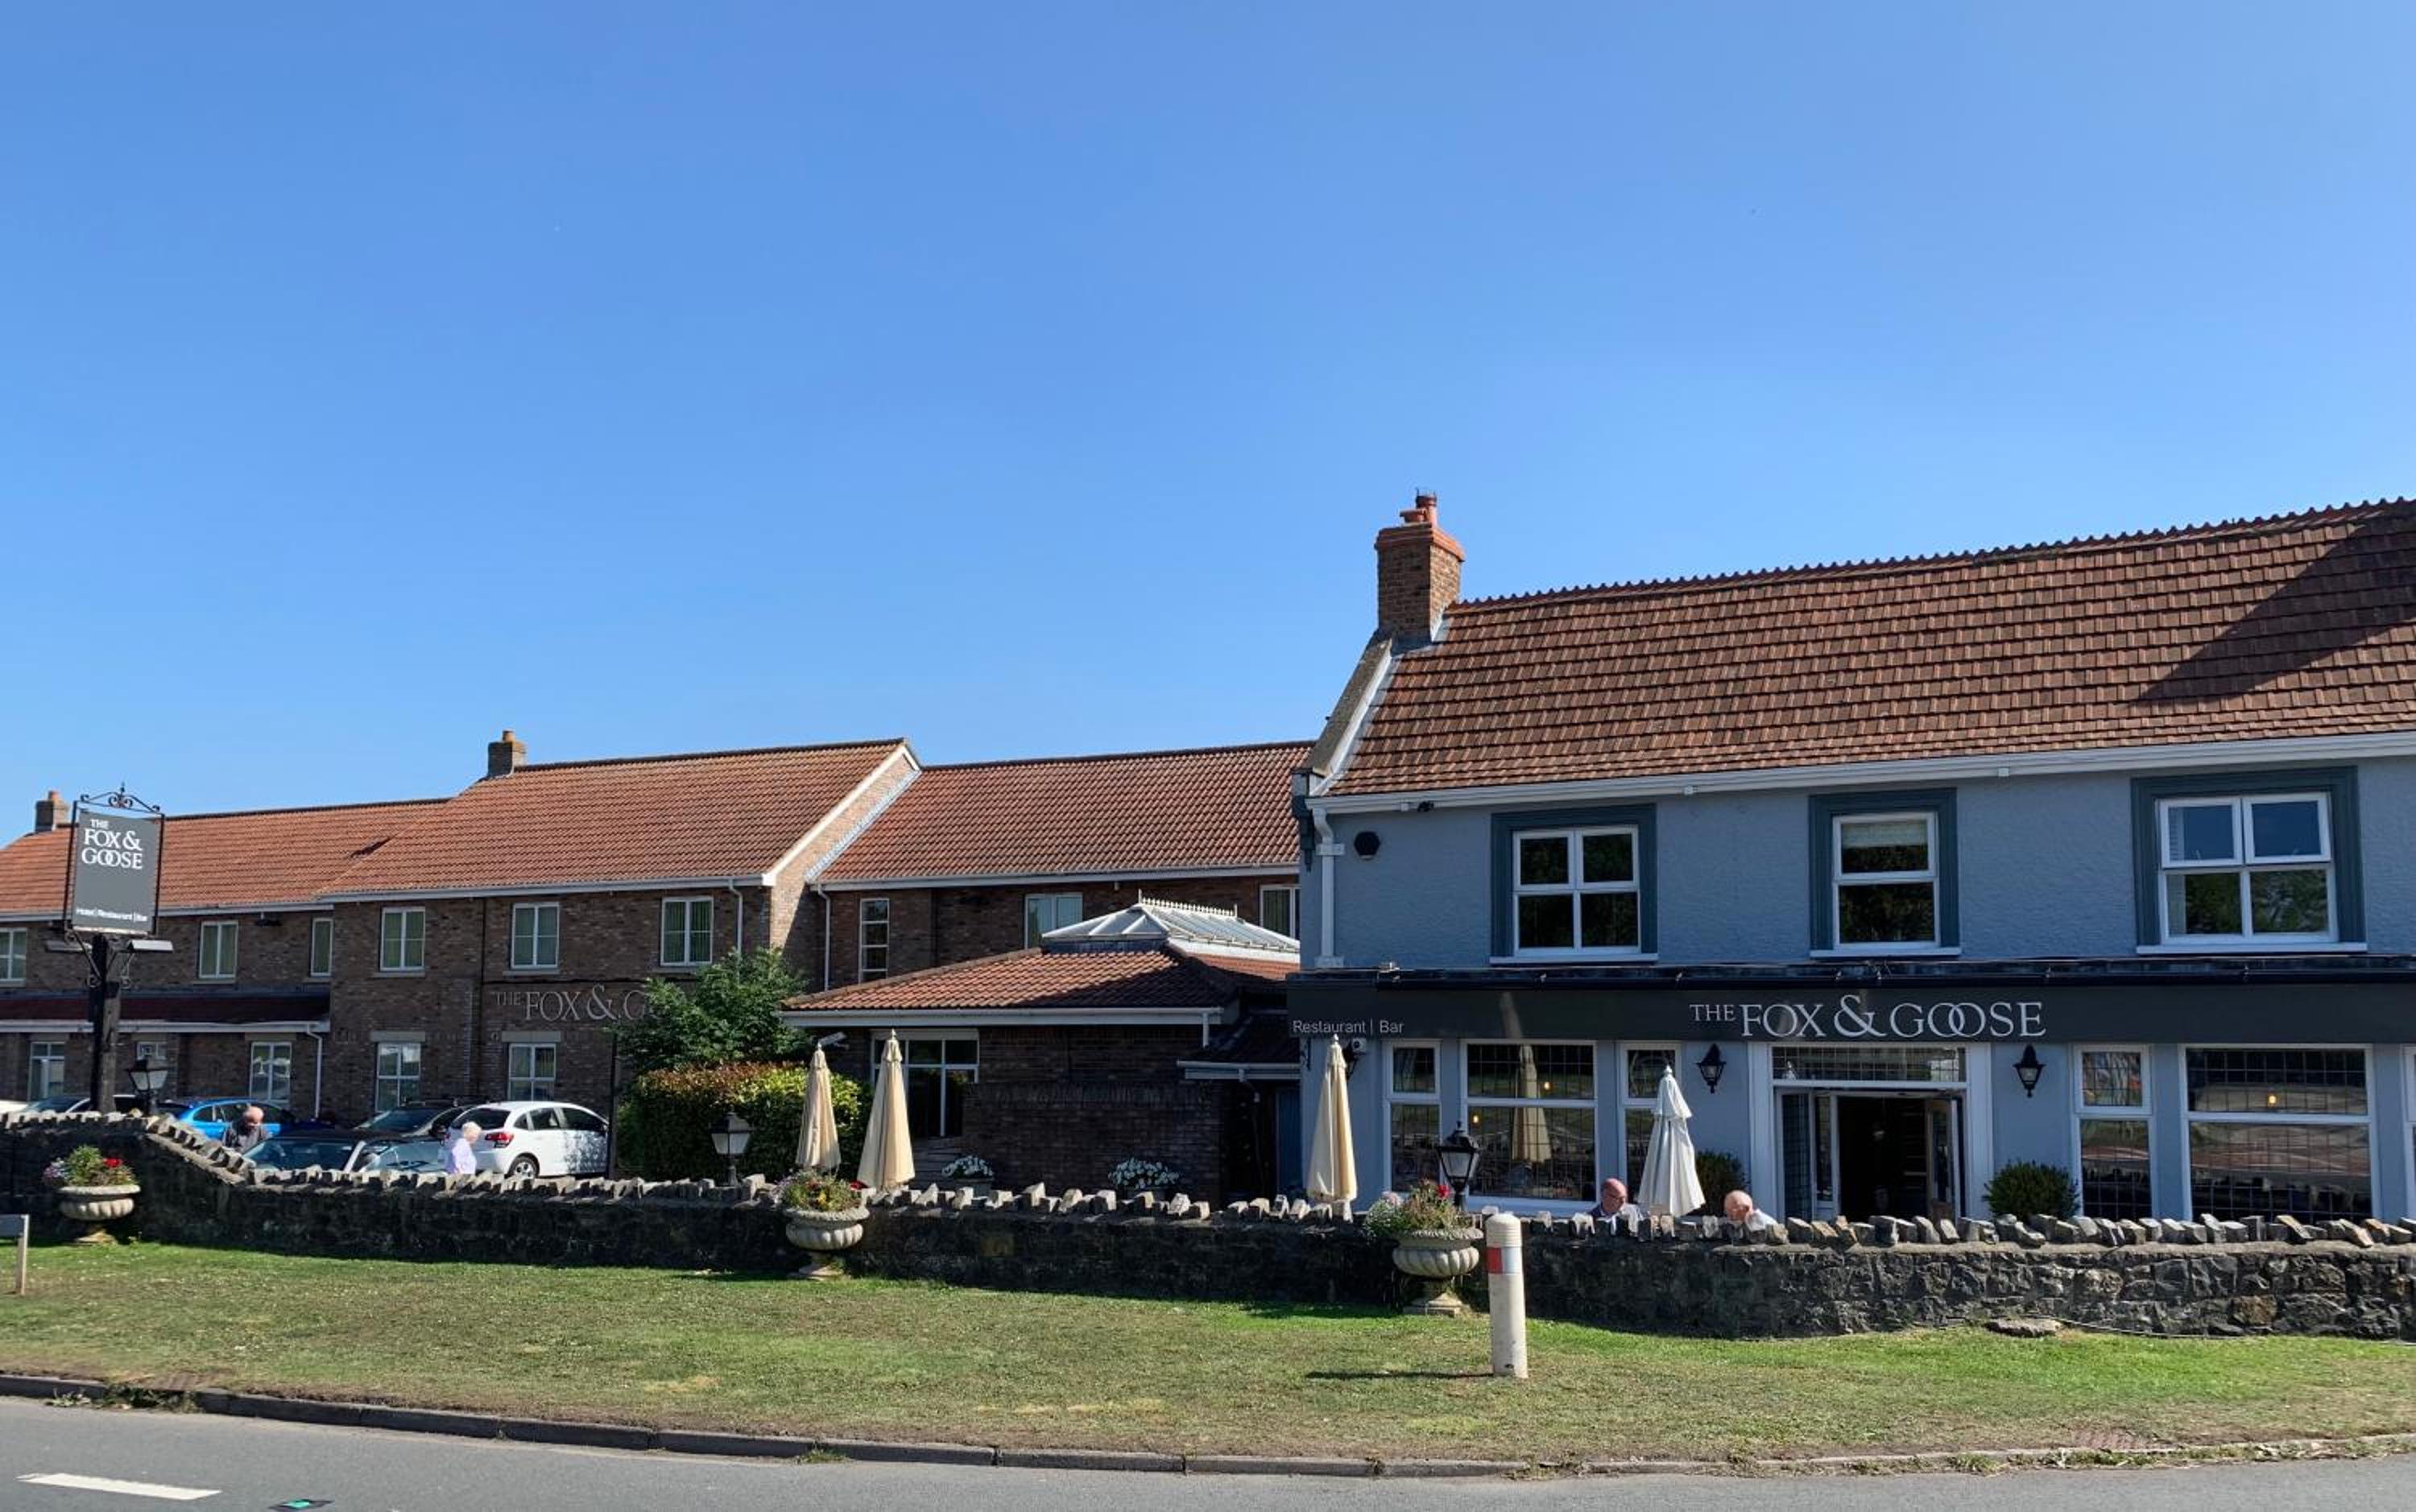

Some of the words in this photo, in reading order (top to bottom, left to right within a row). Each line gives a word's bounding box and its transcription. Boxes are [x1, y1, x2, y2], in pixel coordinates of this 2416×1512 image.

[90, 819, 109, 830] THE
[84, 828, 120, 849] FOX
[122, 830, 143, 851] &
[81, 847, 143, 870] GOOSE
[490, 991, 522, 1006] THE
[524, 991, 581, 1021] FOX
[586, 985, 618, 1020] &
[1293, 1020, 1367, 1033] Restaurant
[1380, 1020, 1405, 1033] Bar
[1690, 1004, 1736, 1022] THE
[1739, 1003, 1826, 1038] FOX
[1834, 994, 1887, 1037] &
[1889, 1002, 2046, 1038] GOOSE
